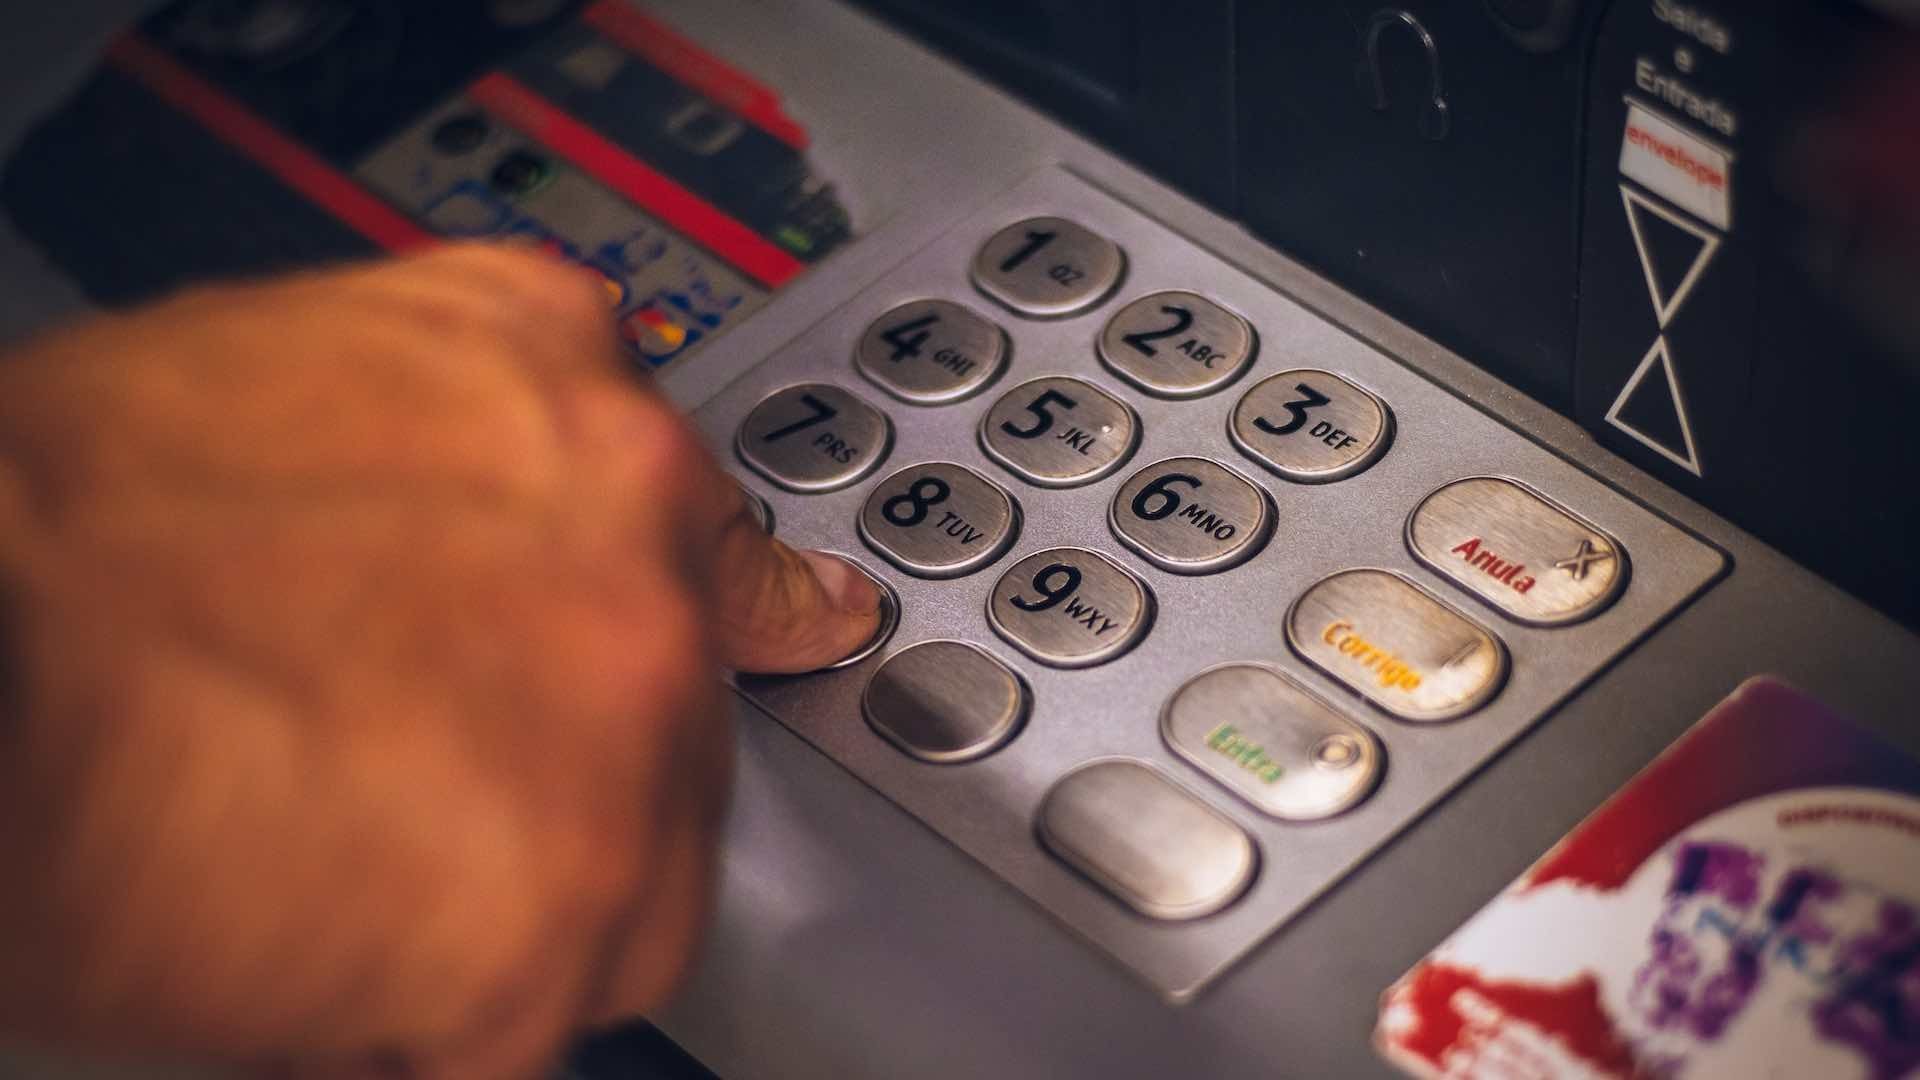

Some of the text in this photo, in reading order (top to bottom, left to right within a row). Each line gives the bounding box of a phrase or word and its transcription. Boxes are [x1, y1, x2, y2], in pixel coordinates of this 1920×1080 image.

[1635, 59, 1737, 136] Entrada
[1627, 126, 1724, 190] envelope
[999, 229, 1056, 272] 1
[880, 311, 976, 377] 4 GHI
[1122, 305, 1226, 369] 2 ABC
[761, 394, 858, 464] 7 PRS
[1001, 389, 1096, 455] 5 JKL
[1252, 383, 1358, 450] 3 DEF
[881, 476, 984, 545] 8 TUV
[1131, 473, 1236, 540] 6 MNO
[1451, 536, 1536, 595] Anula
[1009, 562, 1118, 636] 9 WXY
[1322, 620, 1422, 691] Corrige
[1204, 721, 1284, 784] Entra
